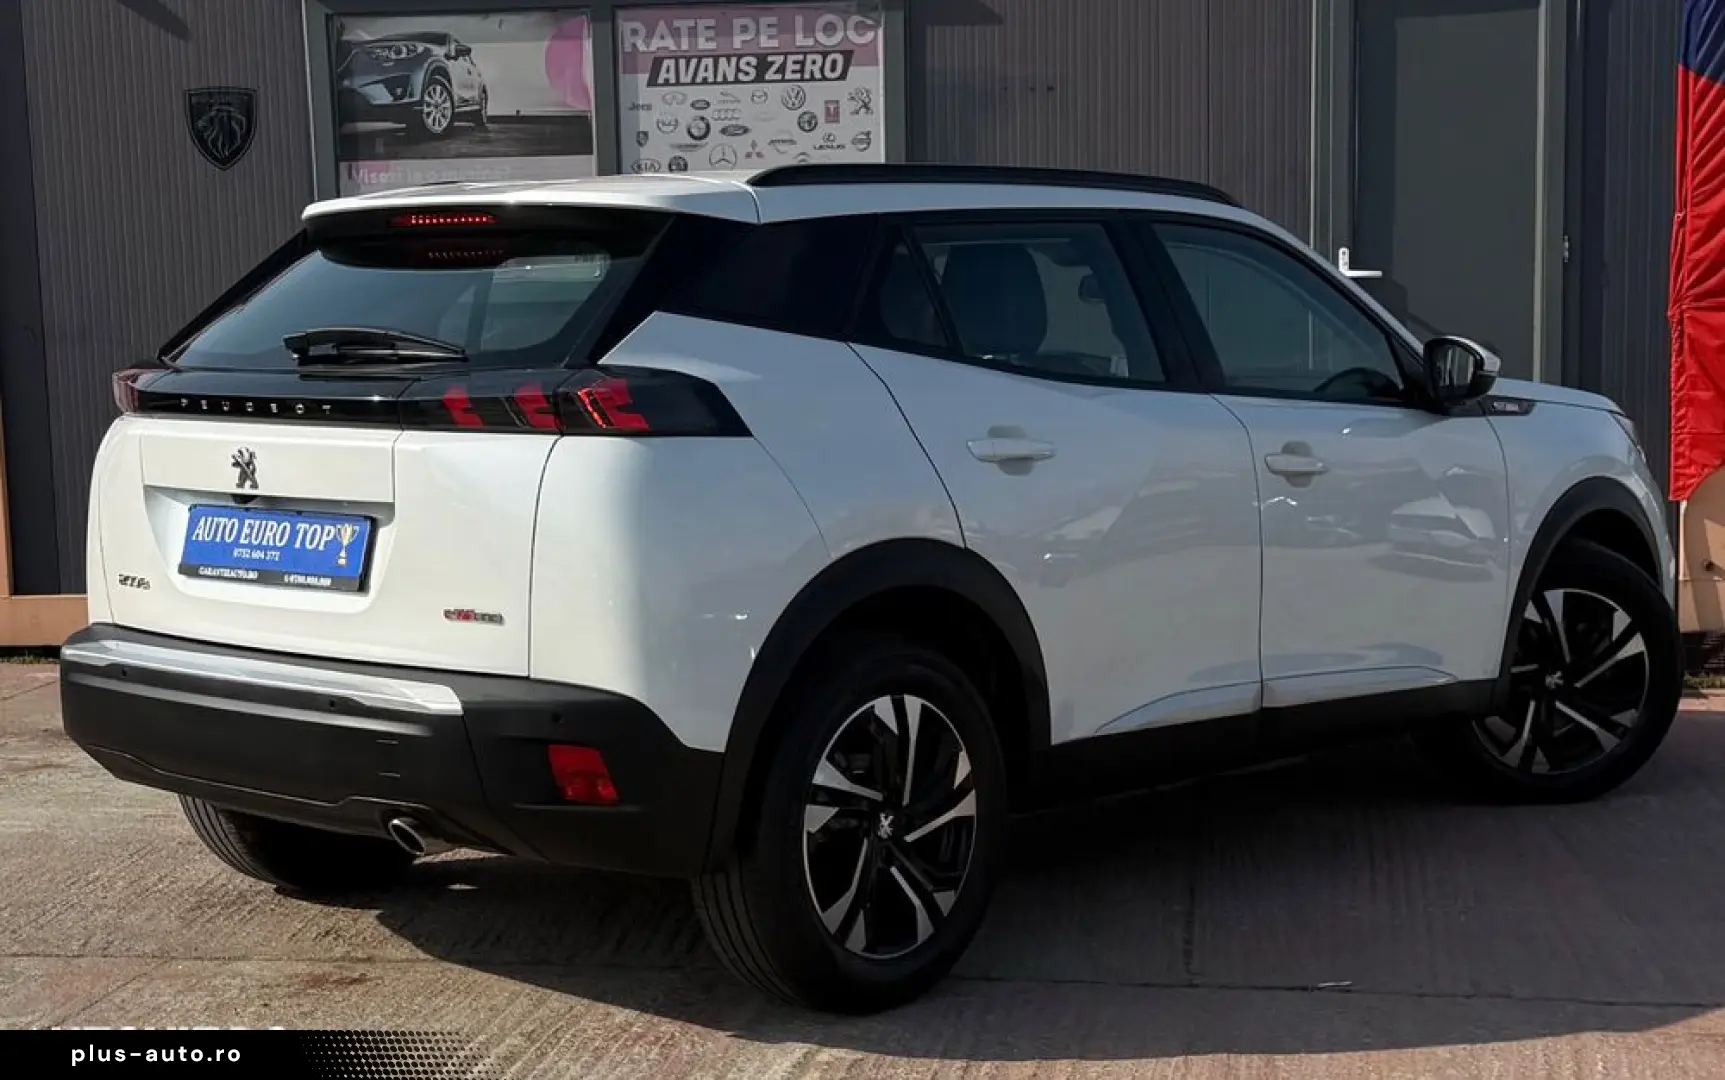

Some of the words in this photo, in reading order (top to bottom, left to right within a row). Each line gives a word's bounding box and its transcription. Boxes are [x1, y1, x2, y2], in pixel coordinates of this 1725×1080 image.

[623, 18, 717, 52] RATE
[732, 17, 779, 49] PE
[795, 13, 876, 46] LOC
[656, 56, 757, 84] AVANS
[764, 53, 845, 81] ZERO
[180, 397, 332, 415] PEUGEOT
[192, 516, 239, 543] AUTO
[239, 518, 291, 547] EURO
[294, 522, 336, 551] TOP
